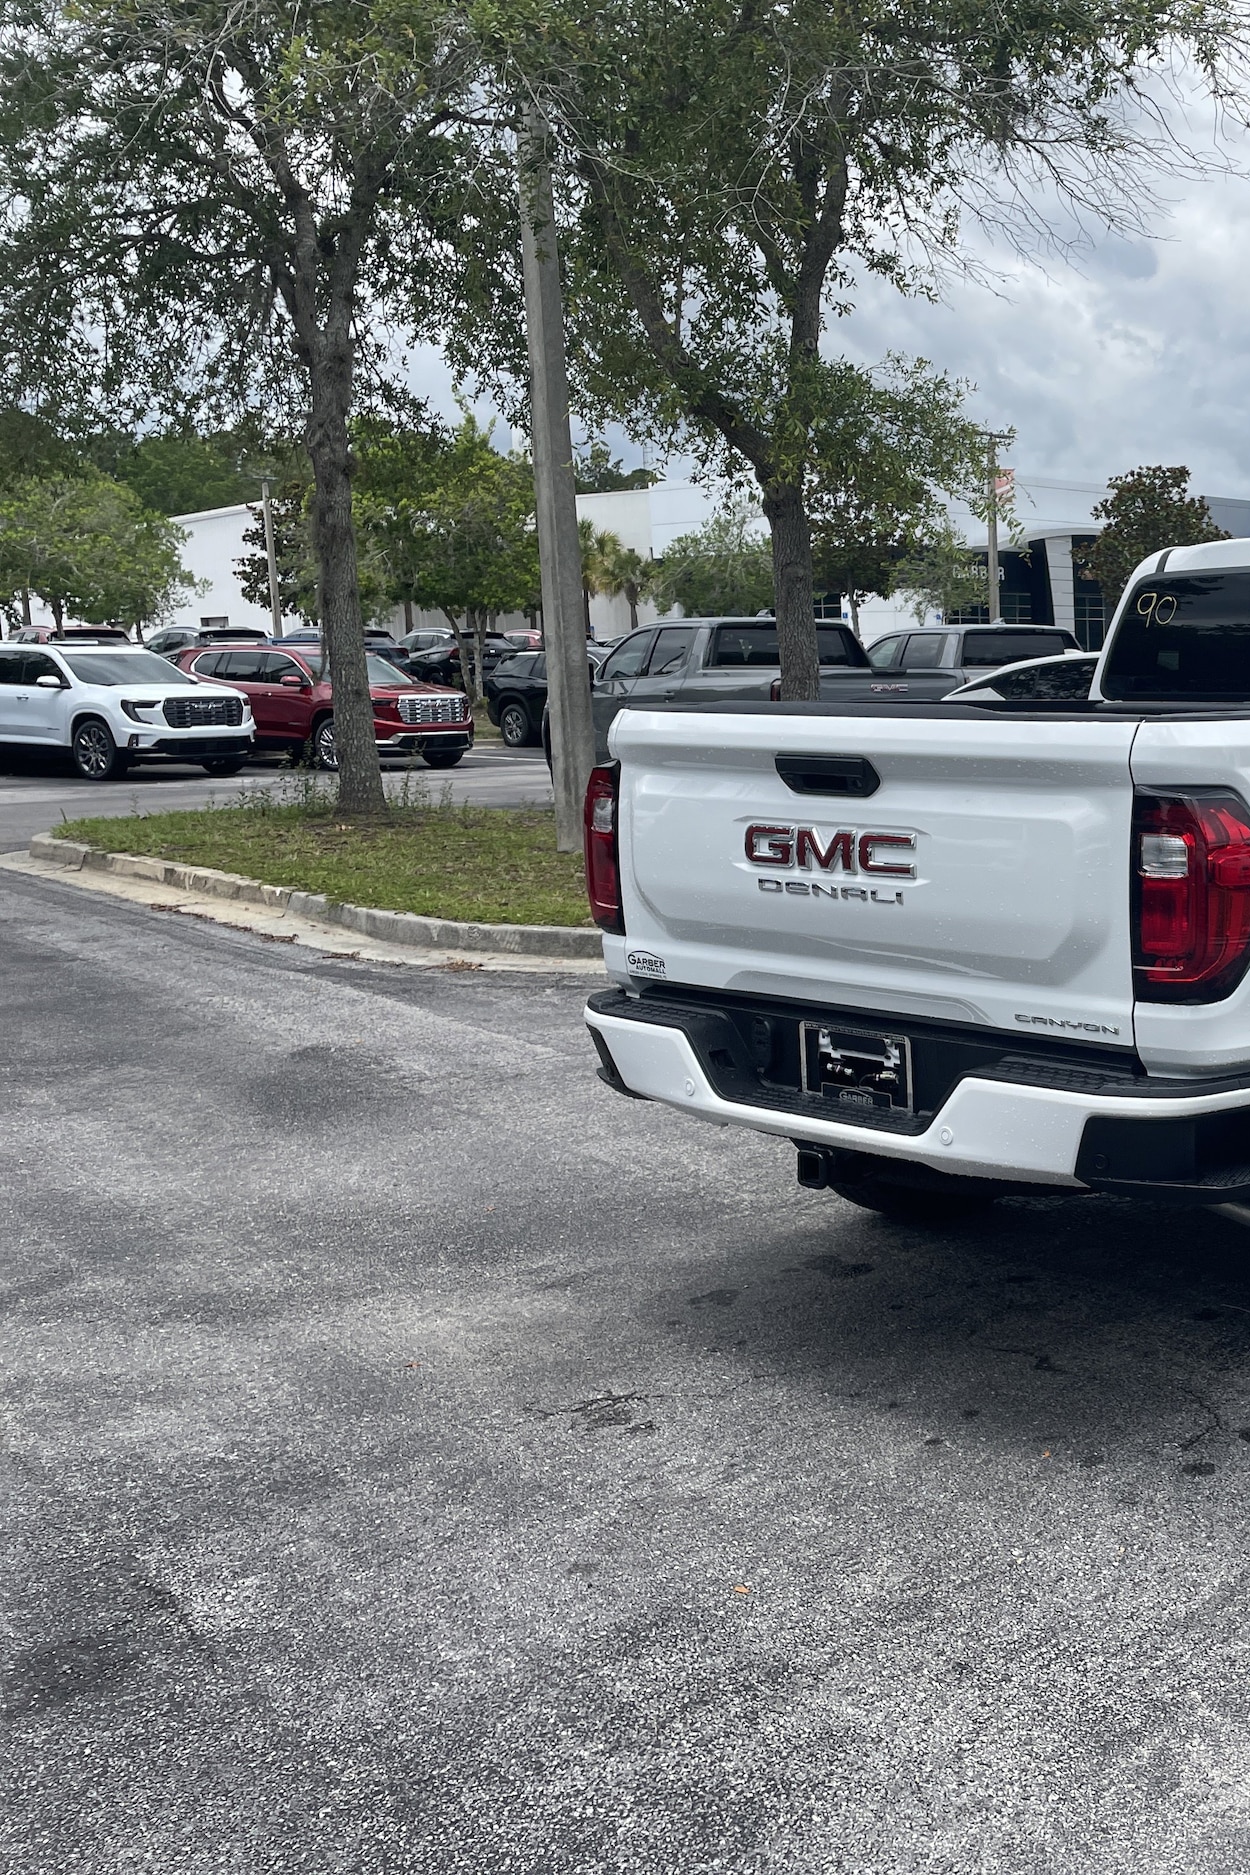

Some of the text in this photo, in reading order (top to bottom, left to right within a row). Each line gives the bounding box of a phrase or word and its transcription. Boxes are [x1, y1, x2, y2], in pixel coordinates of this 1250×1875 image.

[952, 564, 1005, 581] GARBR
[1137, 593, 1177, 628] 90
[745, 823, 917, 879] GMC
[758, 878, 904, 905] DENALI
[627, 953, 666, 969] GARBER
[635, 964, 667, 975] AUTOMALL
[1014, 1013, 1119, 1036] CANYON
[839, 1090, 874, 1105] GARBER
